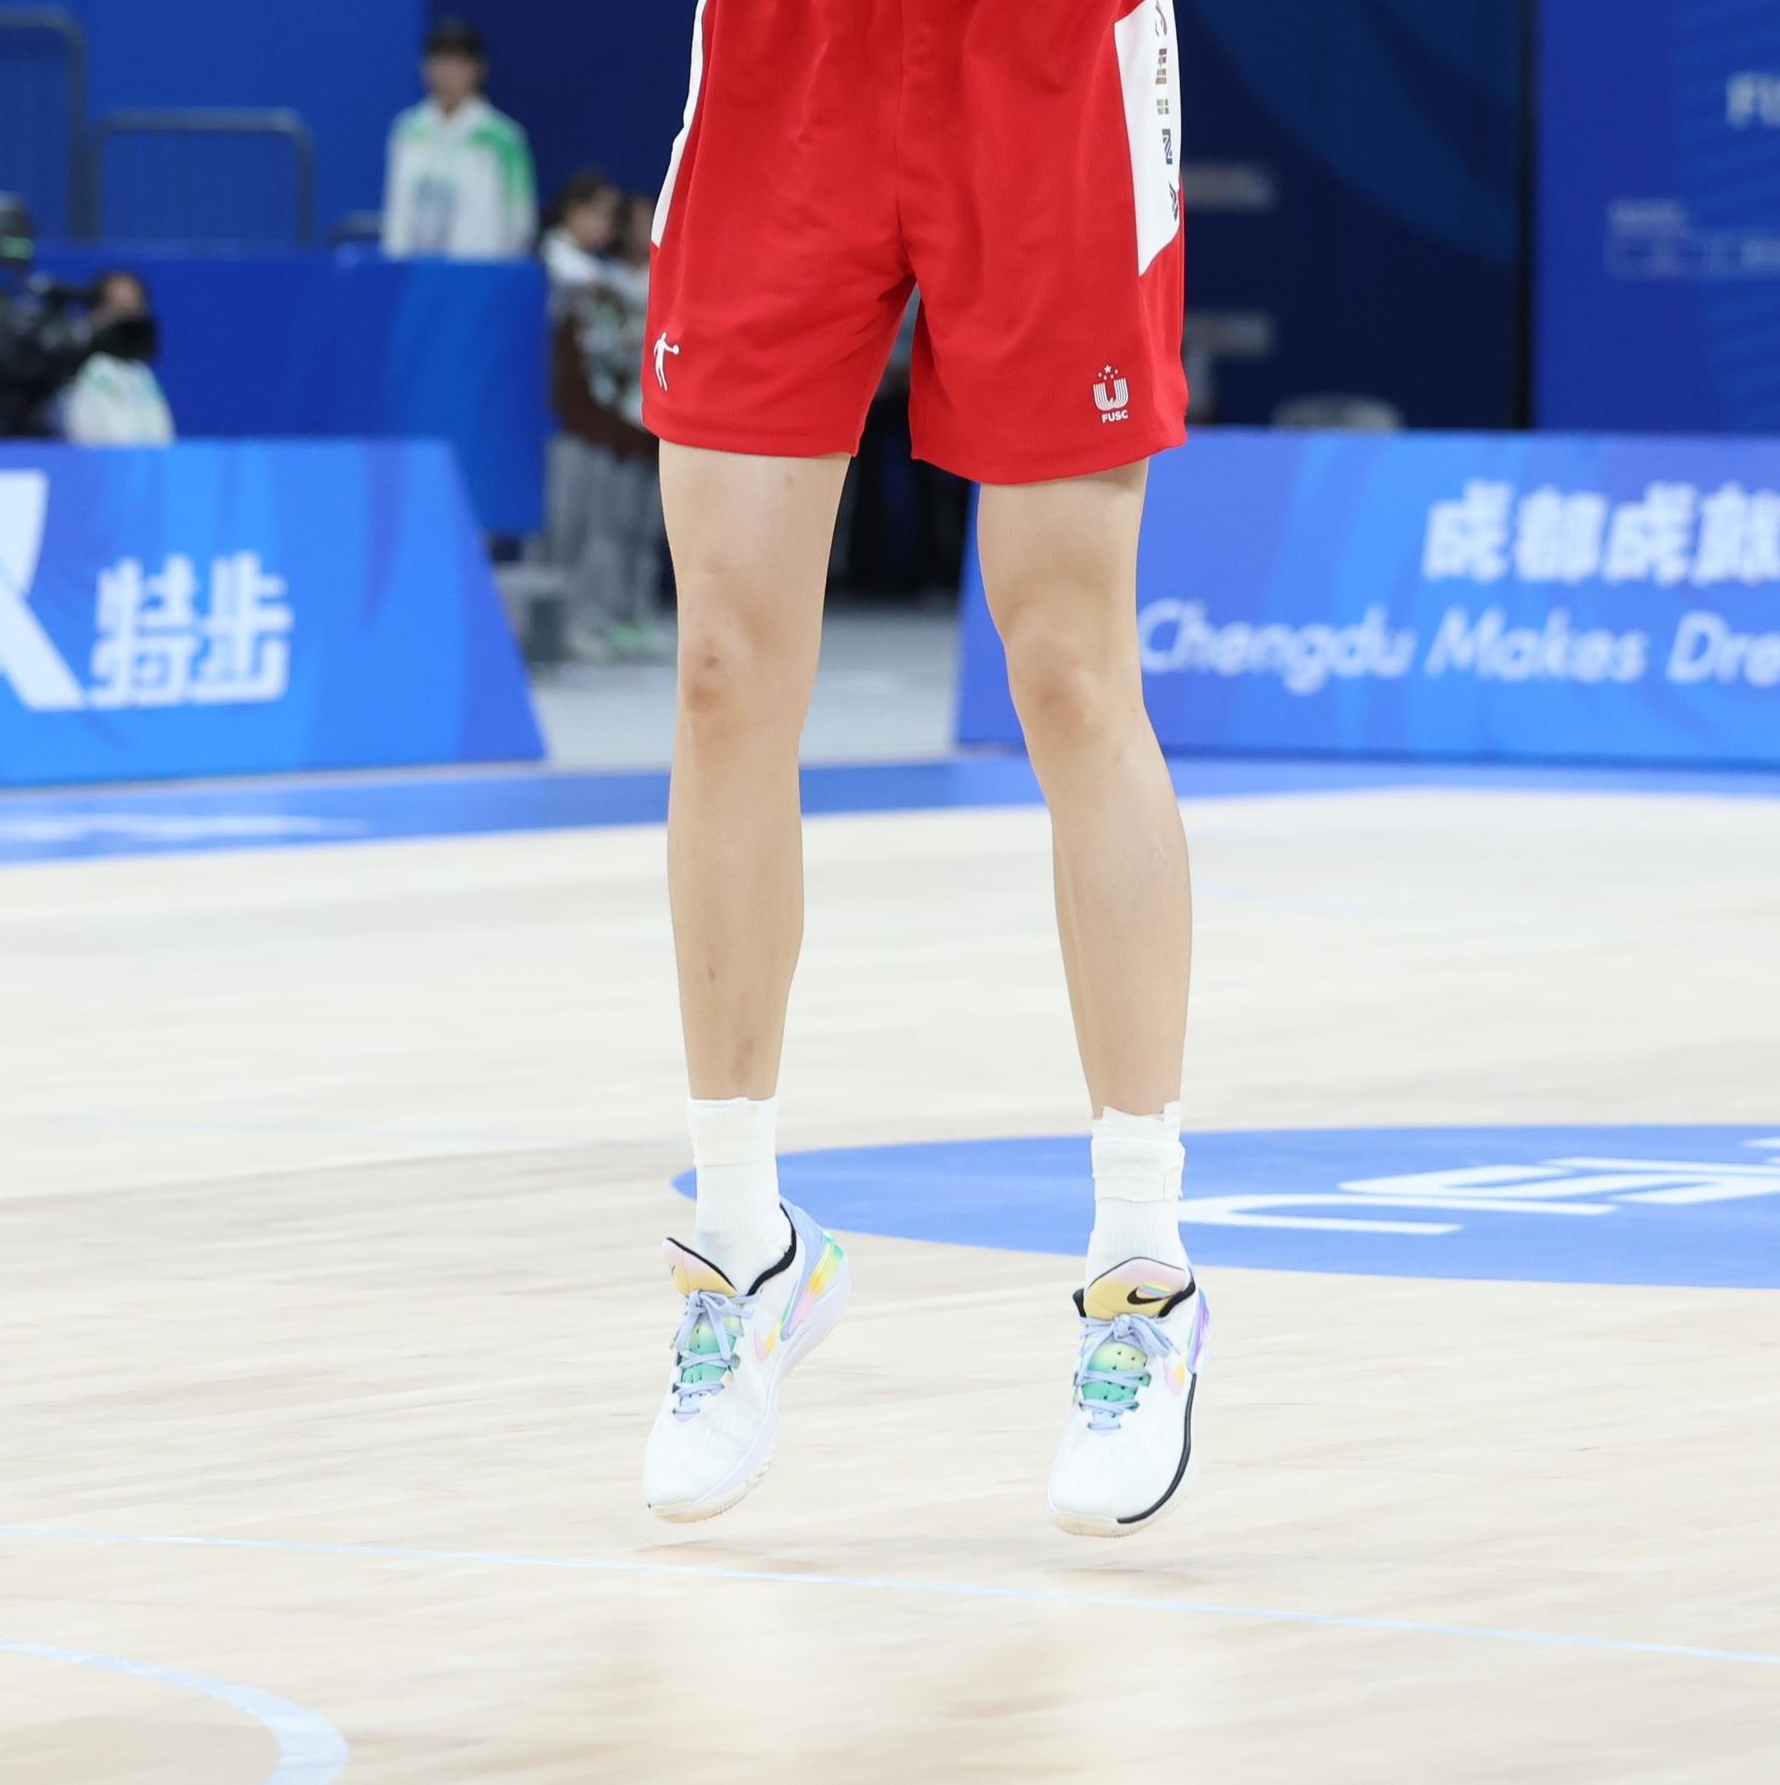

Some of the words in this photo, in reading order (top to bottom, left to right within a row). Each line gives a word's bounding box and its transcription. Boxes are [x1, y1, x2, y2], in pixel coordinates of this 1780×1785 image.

[1101, 410, 1129, 424] FUSC
[88, 551, 293, 710] 特步
[1136, 597, 1417, 696] Chengdu
[1426, 607, 1647, 683] Makes
